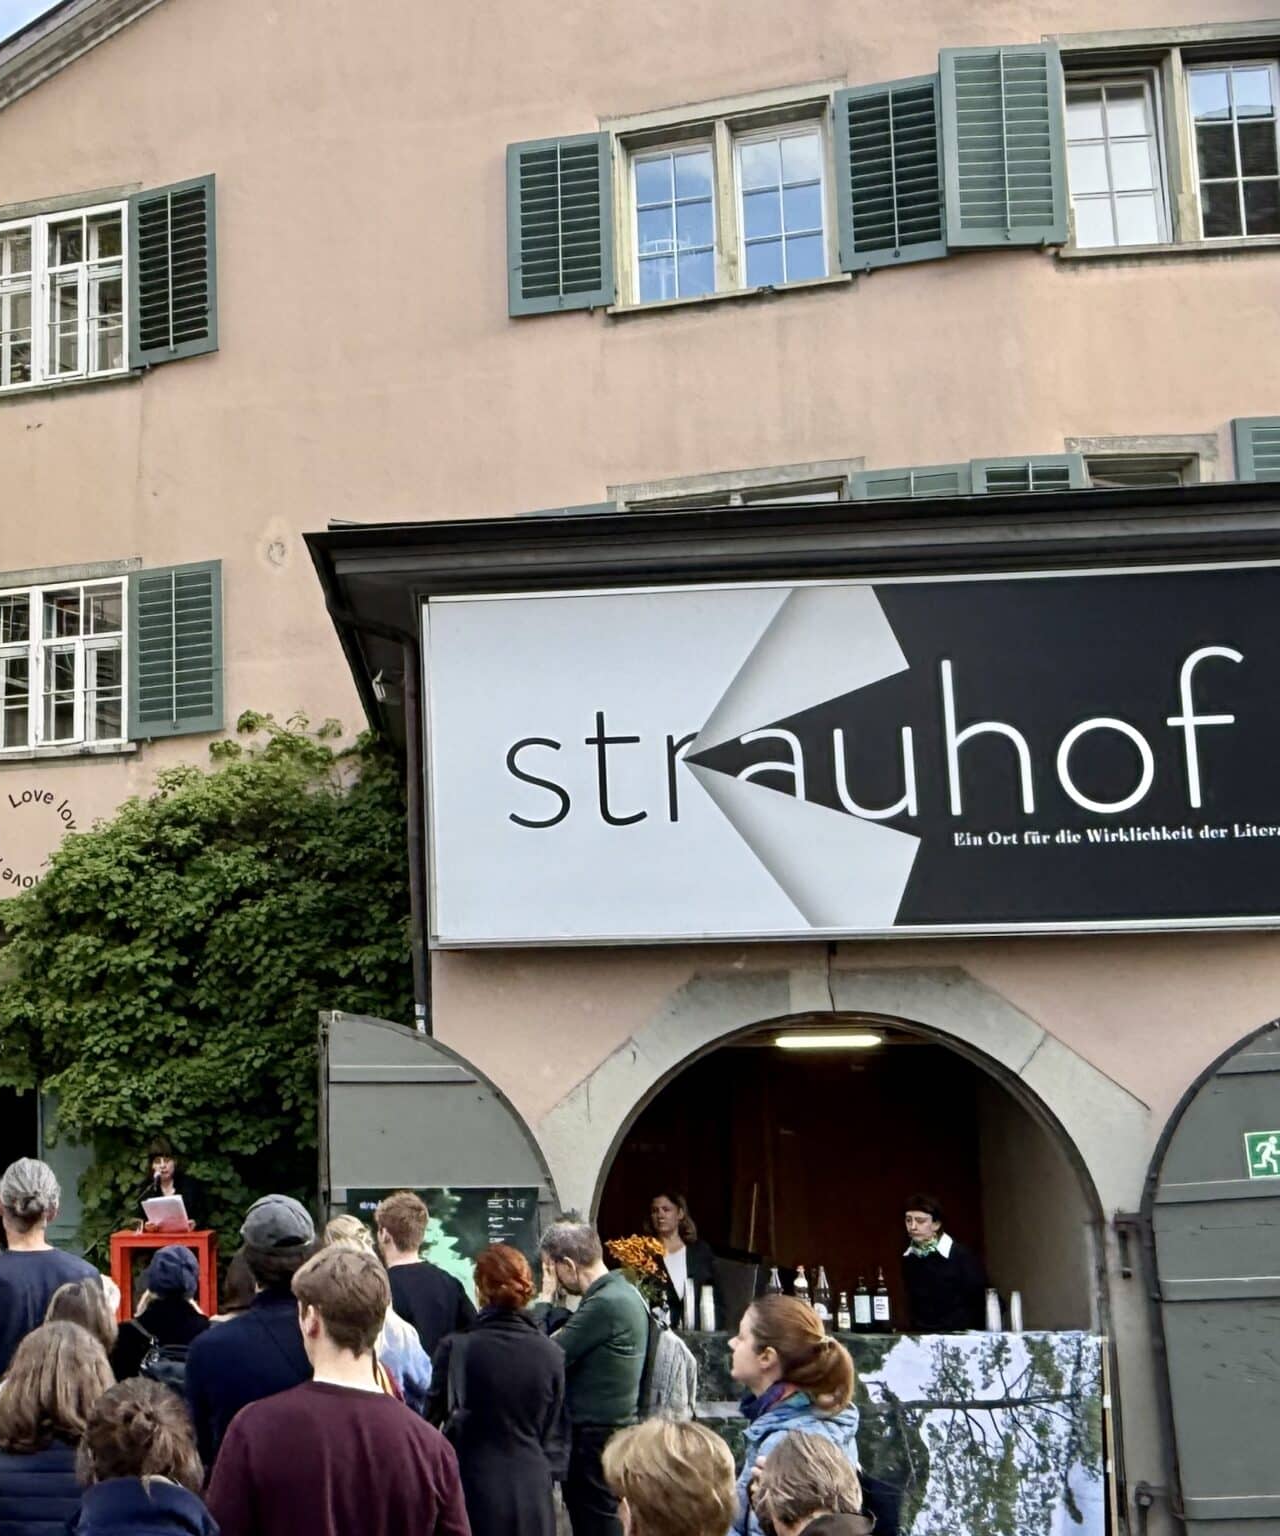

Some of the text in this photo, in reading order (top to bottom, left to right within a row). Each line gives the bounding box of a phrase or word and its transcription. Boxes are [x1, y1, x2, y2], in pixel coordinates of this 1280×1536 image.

[505, 645, 1244, 829] strauhof
[8, 789, 54, 809] Love
[57, 799, 77, 830] lov
[953, 832, 982, 846] Ein
[987, 831, 1018, 845] Ort
[1023, 830, 1051, 845] für
[1055, 829, 1082, 844] die
[1086, 826, 1194, 844] Wirklichkeit
[1199, 824, 1228, 839] der
